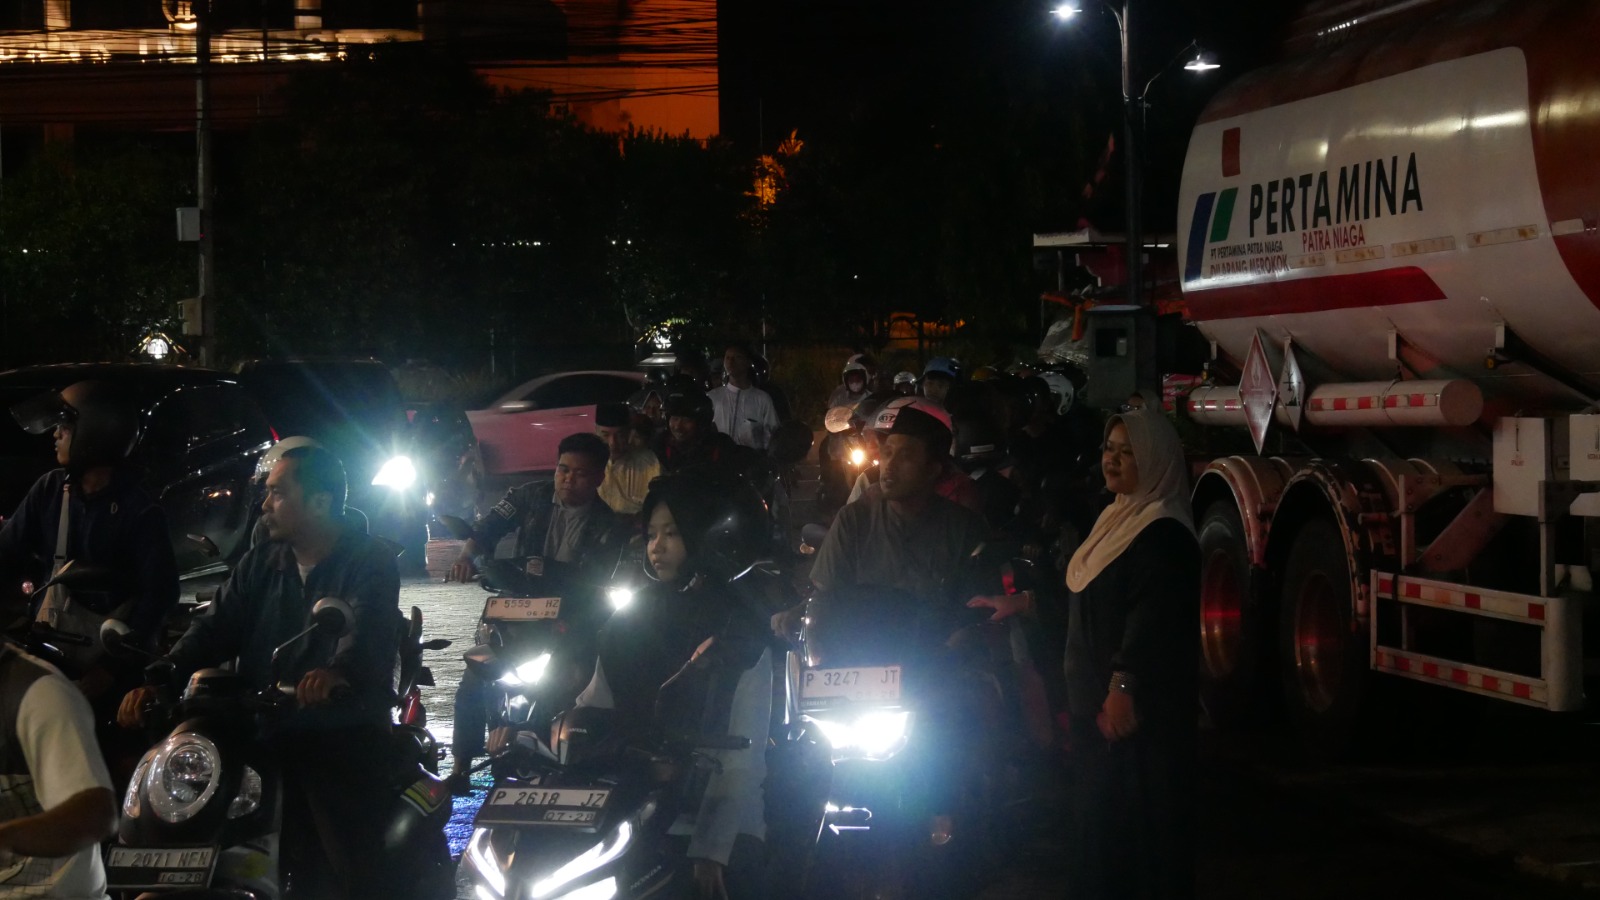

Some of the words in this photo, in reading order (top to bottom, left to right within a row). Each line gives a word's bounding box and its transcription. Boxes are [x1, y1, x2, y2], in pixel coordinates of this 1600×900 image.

[1249, 152, 1423, 238] PERTAMINA
[1302, 229, 1331, 252] PATRA
[1333, 224, 1366, 249] NIAGA
[1218, 244, 1247, 259] PERTAMINA
[1247, 242, 1264, 254] PATRA
[1265, 240, 1283, 253] NIAGA
[1250, 254, 1290, 275] MEROKOK
[490, 600, 498, 608] P
[504, 600, 532, 608] 5559
[545, 600, 560, 608] HZ
[805, 673, 815, 687] P
[824, 671, 860, 687] 3247
[880, 669, 898, 684] JT
[493, 792, 507, 805] P
[514, 791, 560, 806] 2618
[581, 793, 605, 807] JZ
[131, 851, 172, 868] 2071
